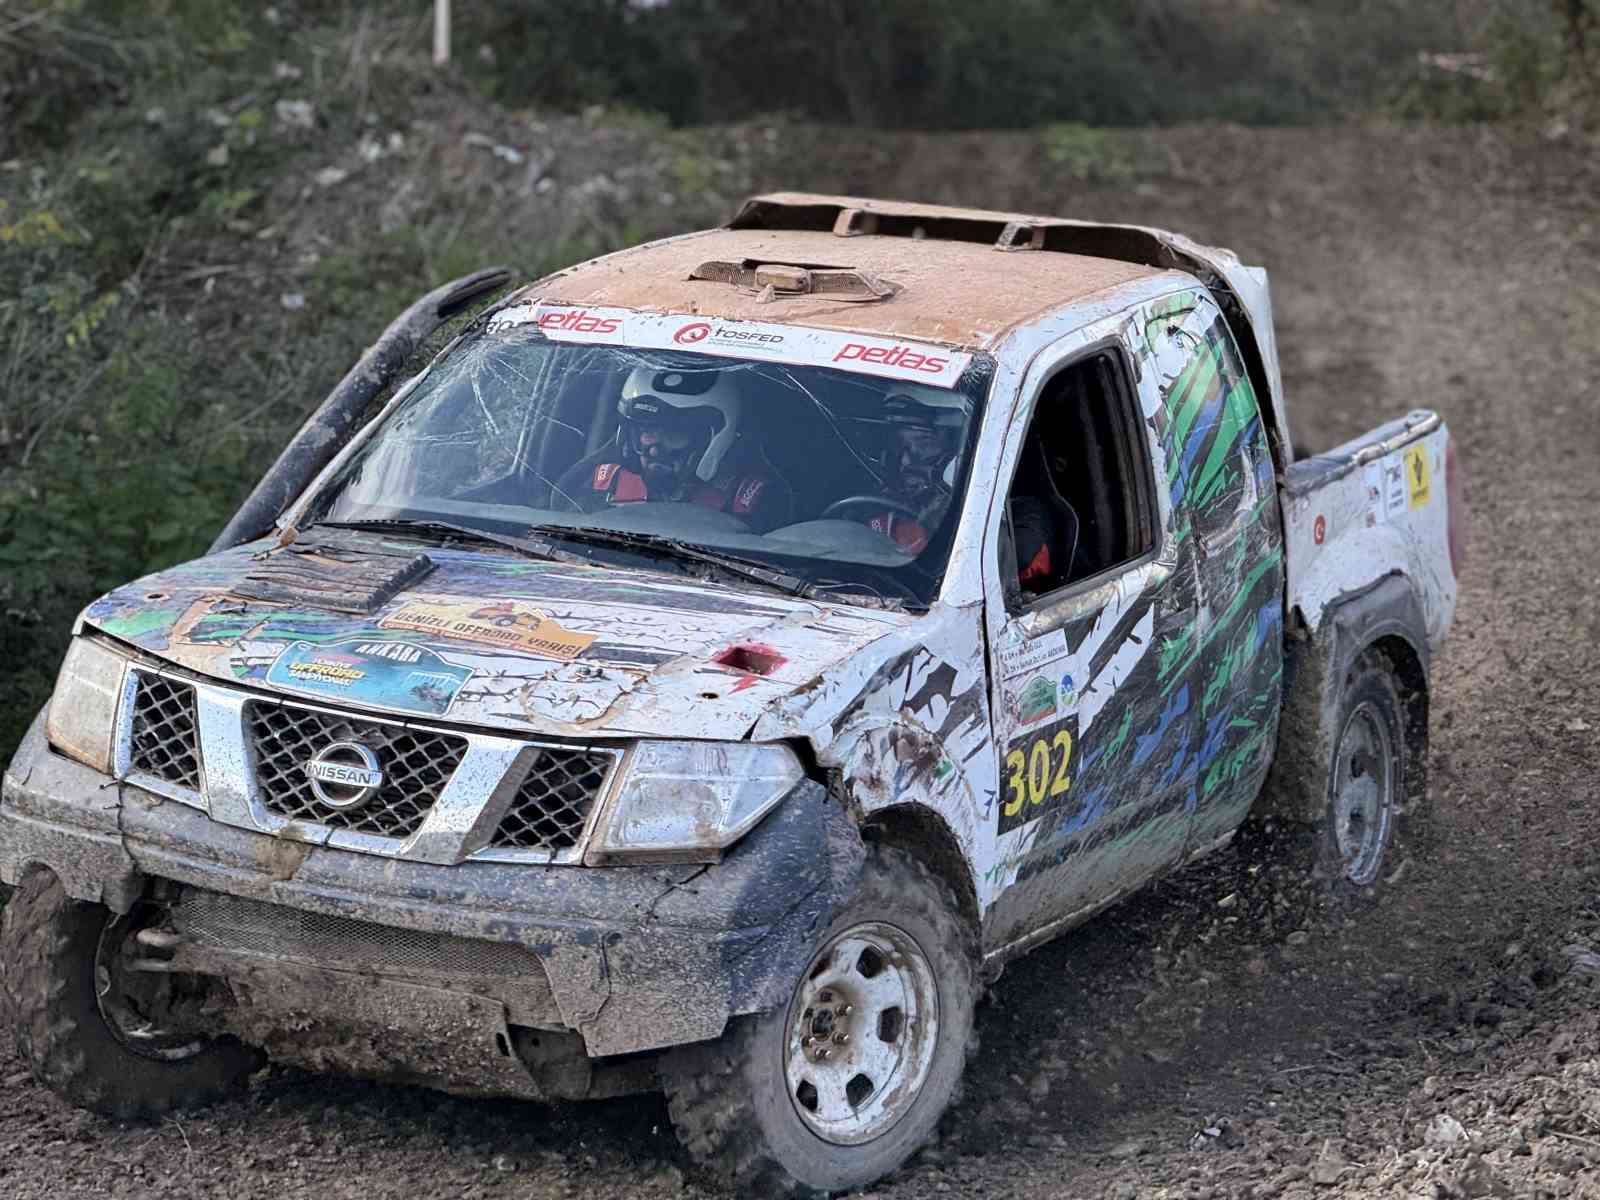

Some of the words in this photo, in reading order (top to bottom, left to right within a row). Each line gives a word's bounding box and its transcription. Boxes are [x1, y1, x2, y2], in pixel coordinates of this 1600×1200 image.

[832, 343, 949, 373] petlas
[453, 623, 522, 641] OFFROAD
[355, 644, 422, 662] ANKARA
[309, 764, 371, 784] NISSAN
[1005, 729, 1072, 816] 302
